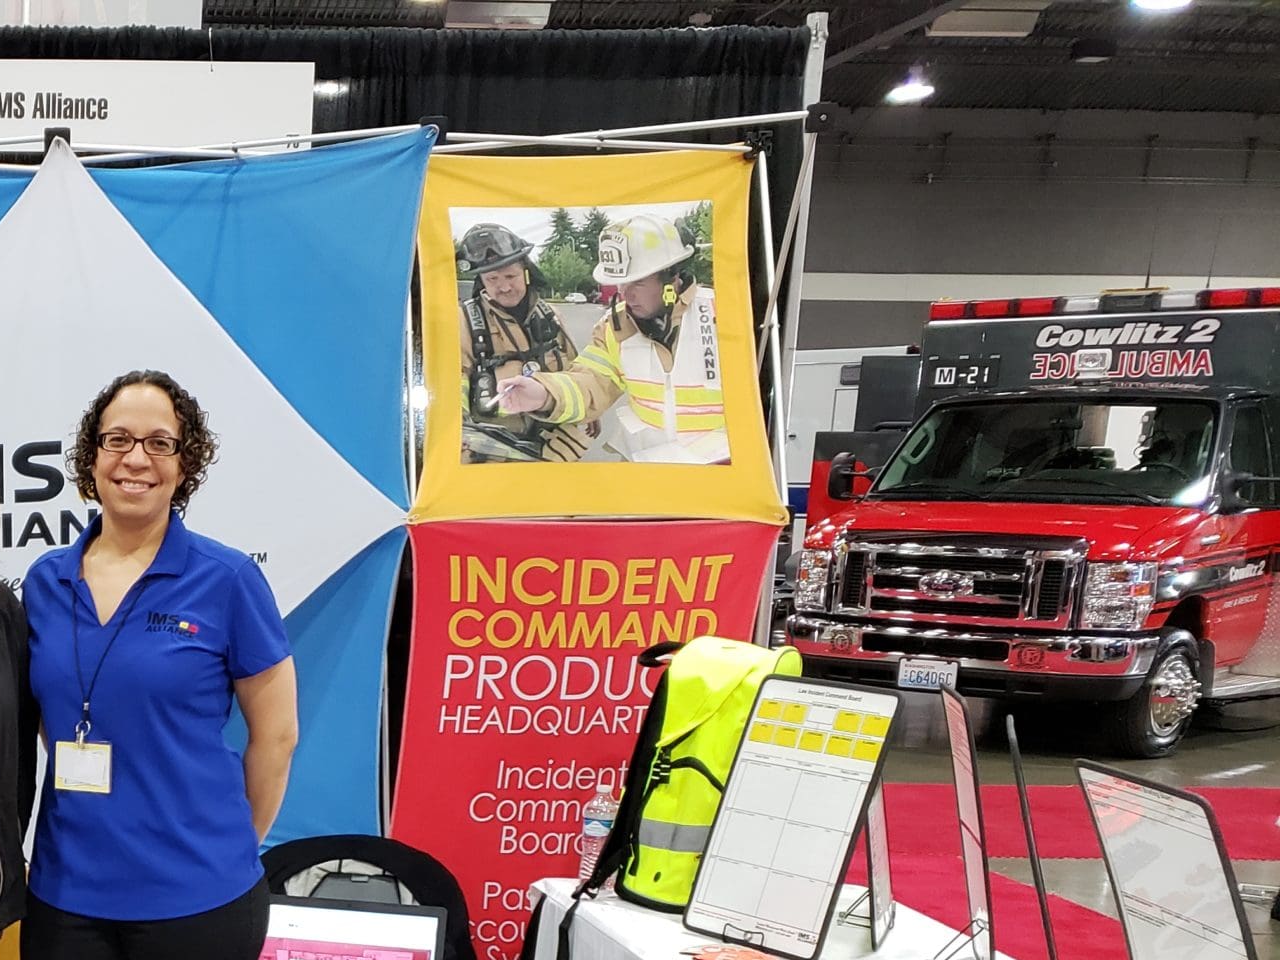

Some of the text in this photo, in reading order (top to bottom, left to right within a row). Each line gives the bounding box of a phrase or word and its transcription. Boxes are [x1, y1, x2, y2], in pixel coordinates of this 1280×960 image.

[32, 92, 108, 120] Alliance
[1036, 318, 1221, 348] Cowlitz 2
[448, 553, 735, 606] INCIDENT
[147, 610, 180, 625] IMS
[448, 607, 719, 649] COMMAND
